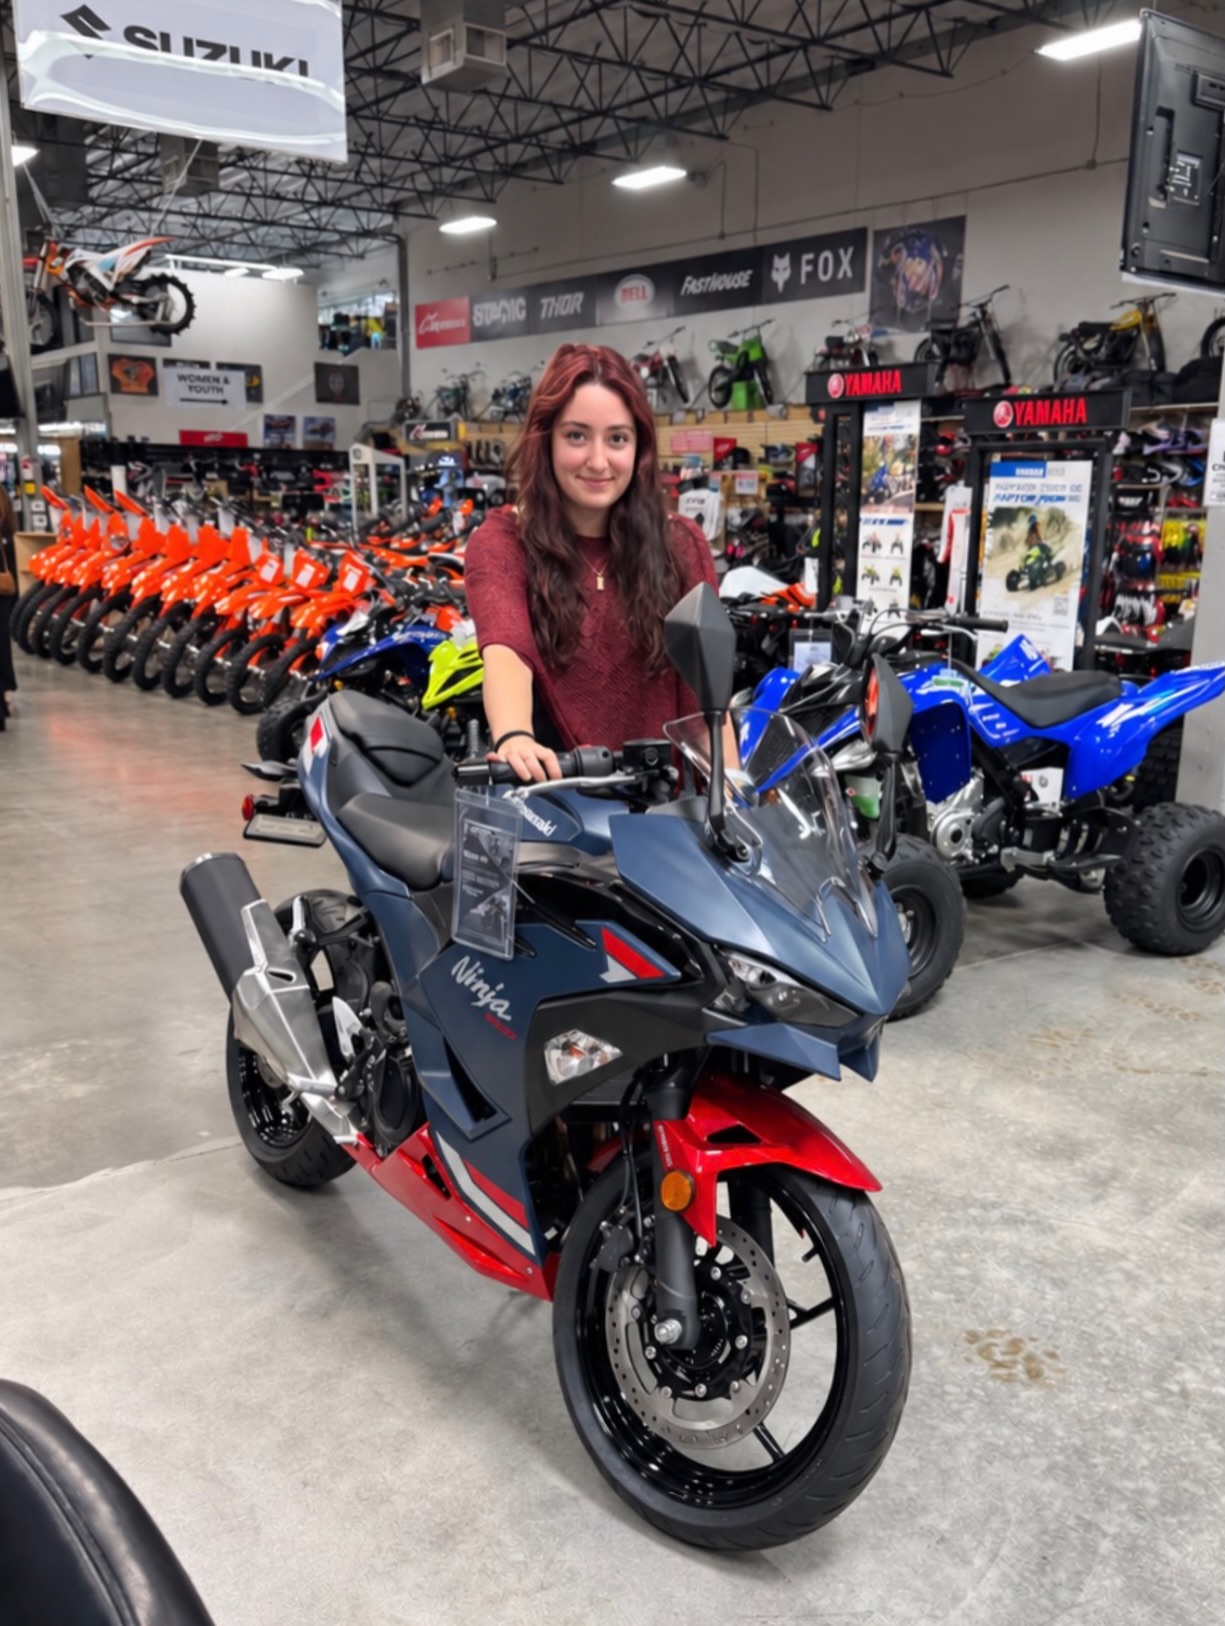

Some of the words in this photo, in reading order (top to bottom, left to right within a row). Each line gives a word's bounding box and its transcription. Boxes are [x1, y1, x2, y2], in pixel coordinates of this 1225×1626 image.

[801, 247, 854, 285] FOX
[620, 286, 648, 303] BELL
[680, 270, 753, 297] FASTHOUSE
[540, 291, 584, 320] THOR
[177, 374, 221, 385] WOMEN
[223, 375, 231, 385] &
[187, 385, 224, 394] YOUTH
[845, 369, 902, 396] YAMAHA
[1014, 398, 1087, 426] YAMAHA
[451, 955, 512, 1022] Ninja
